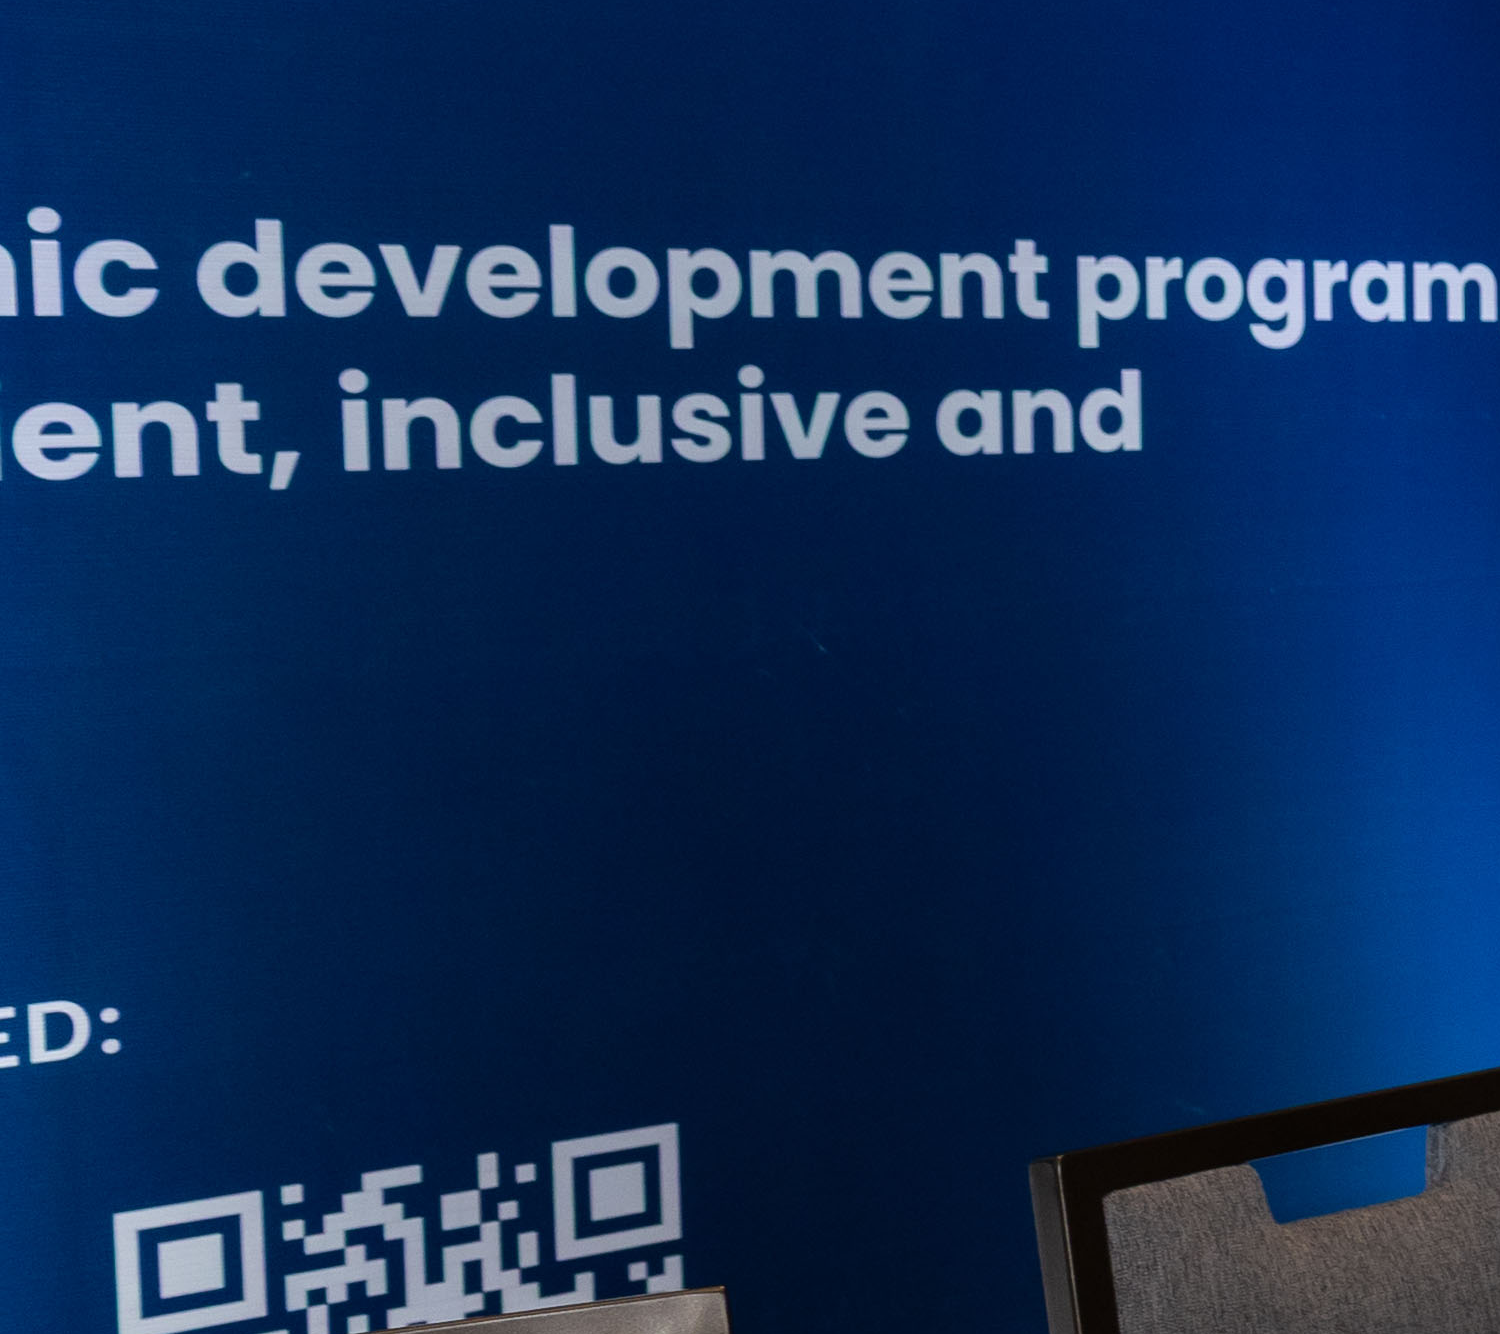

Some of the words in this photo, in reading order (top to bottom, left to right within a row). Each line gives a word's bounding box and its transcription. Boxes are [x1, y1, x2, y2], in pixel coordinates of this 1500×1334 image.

[0, 206, 160, 319] ic
[197, 218, 1049, 348] development
[0, 382, 300, 490] ent,
[339, 365, 911, 471] inclusive
[936, 370, 1144, 458] and
